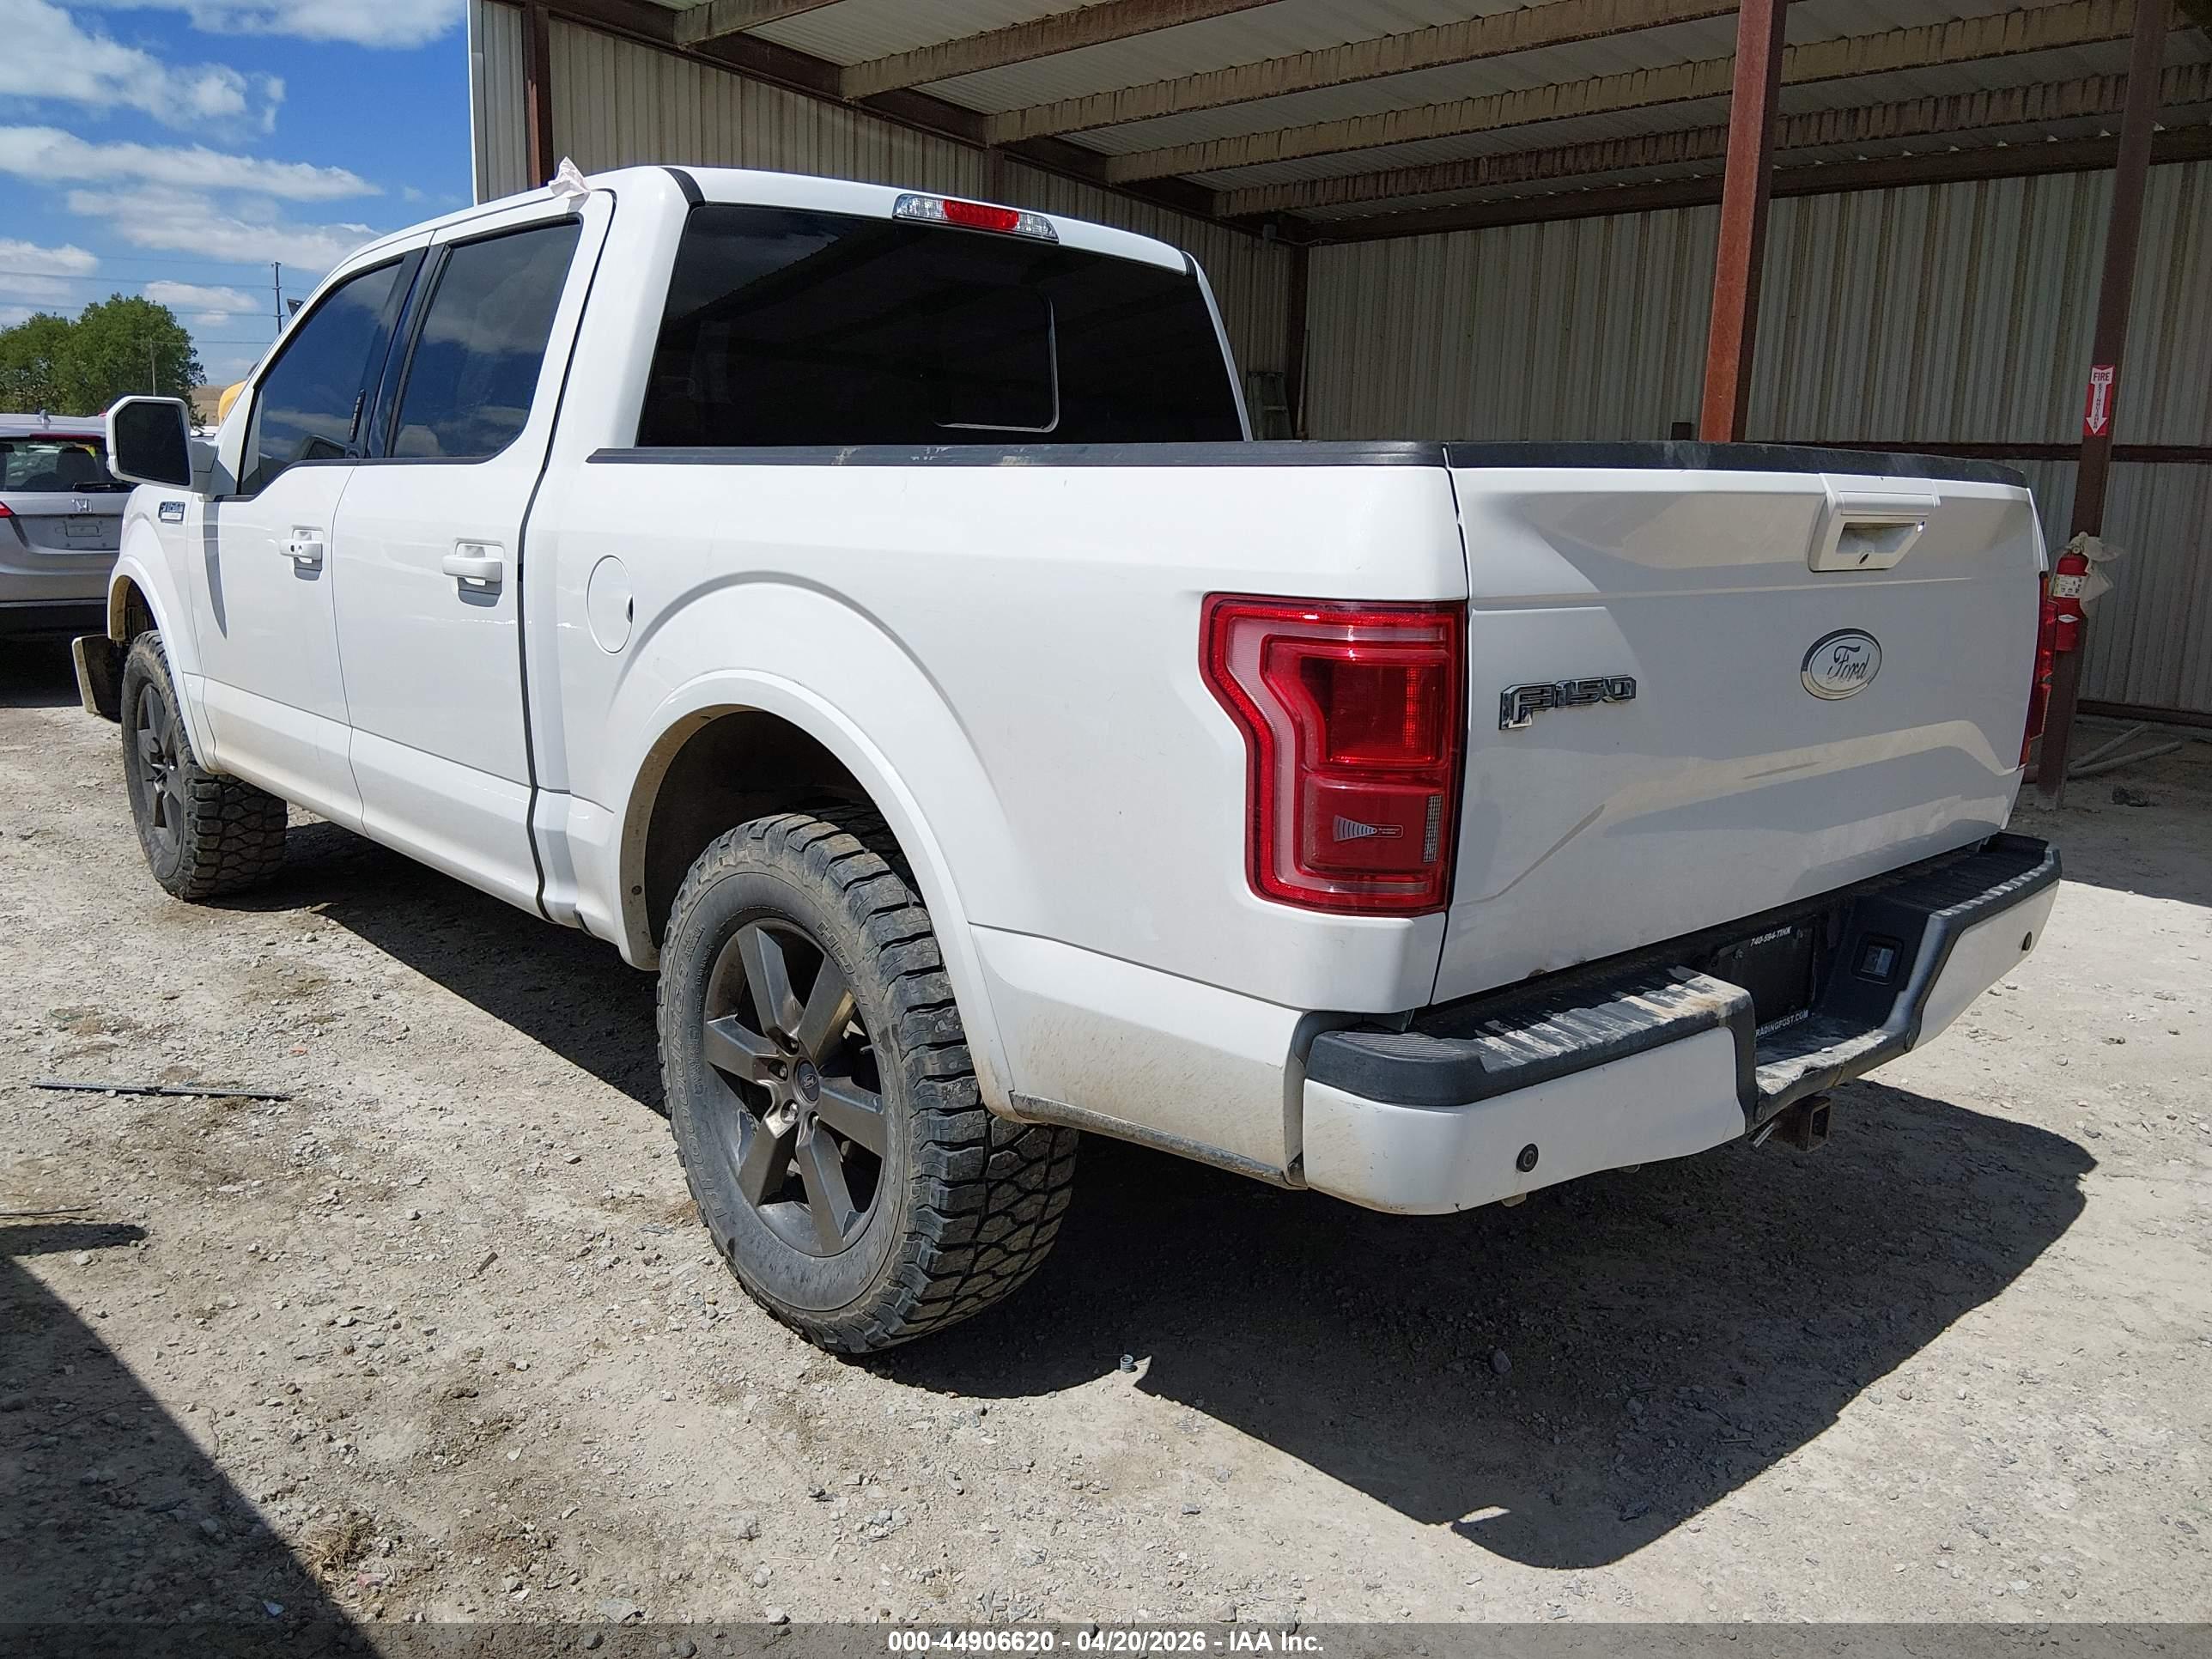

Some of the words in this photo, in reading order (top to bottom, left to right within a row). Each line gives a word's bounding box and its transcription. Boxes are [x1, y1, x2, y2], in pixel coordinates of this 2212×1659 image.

[2093, 372, 2111, 382] FIRE
[1826, 644, 1871, 685] Ford
[1754, 1009, 1809, 1039] RADINGPOST.COM
